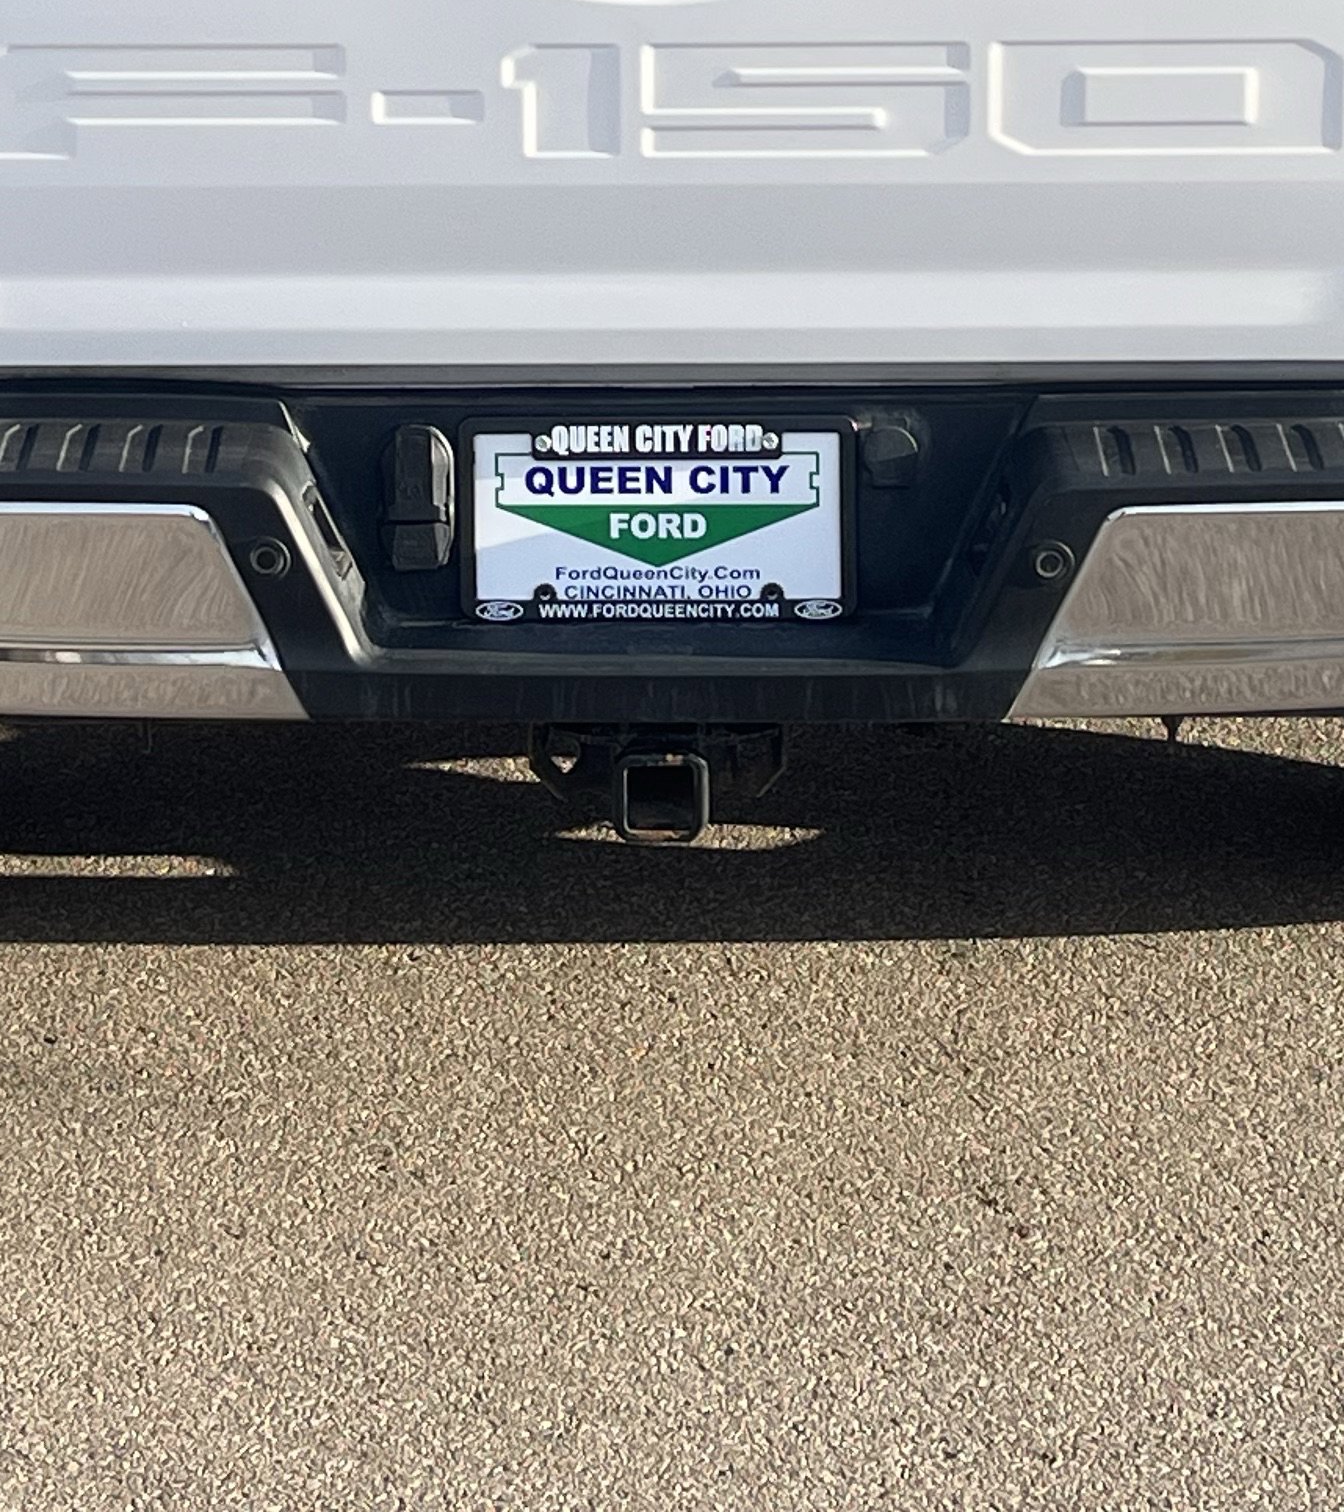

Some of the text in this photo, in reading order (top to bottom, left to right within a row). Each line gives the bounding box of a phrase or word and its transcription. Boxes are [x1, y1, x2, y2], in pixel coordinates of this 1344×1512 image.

[552, 424, 763, 454] QUEEN CITY FORD
[525, 465, 790, 496] QUEEN CITY
[609, 513, 708, 540] FORD
[555, 566, 761, 582] FordQueenCity.Com
[698, 585, 752, 600] OHIO
[539, 603, 780, 619] WWW.FORDQUEENCITY.COM
